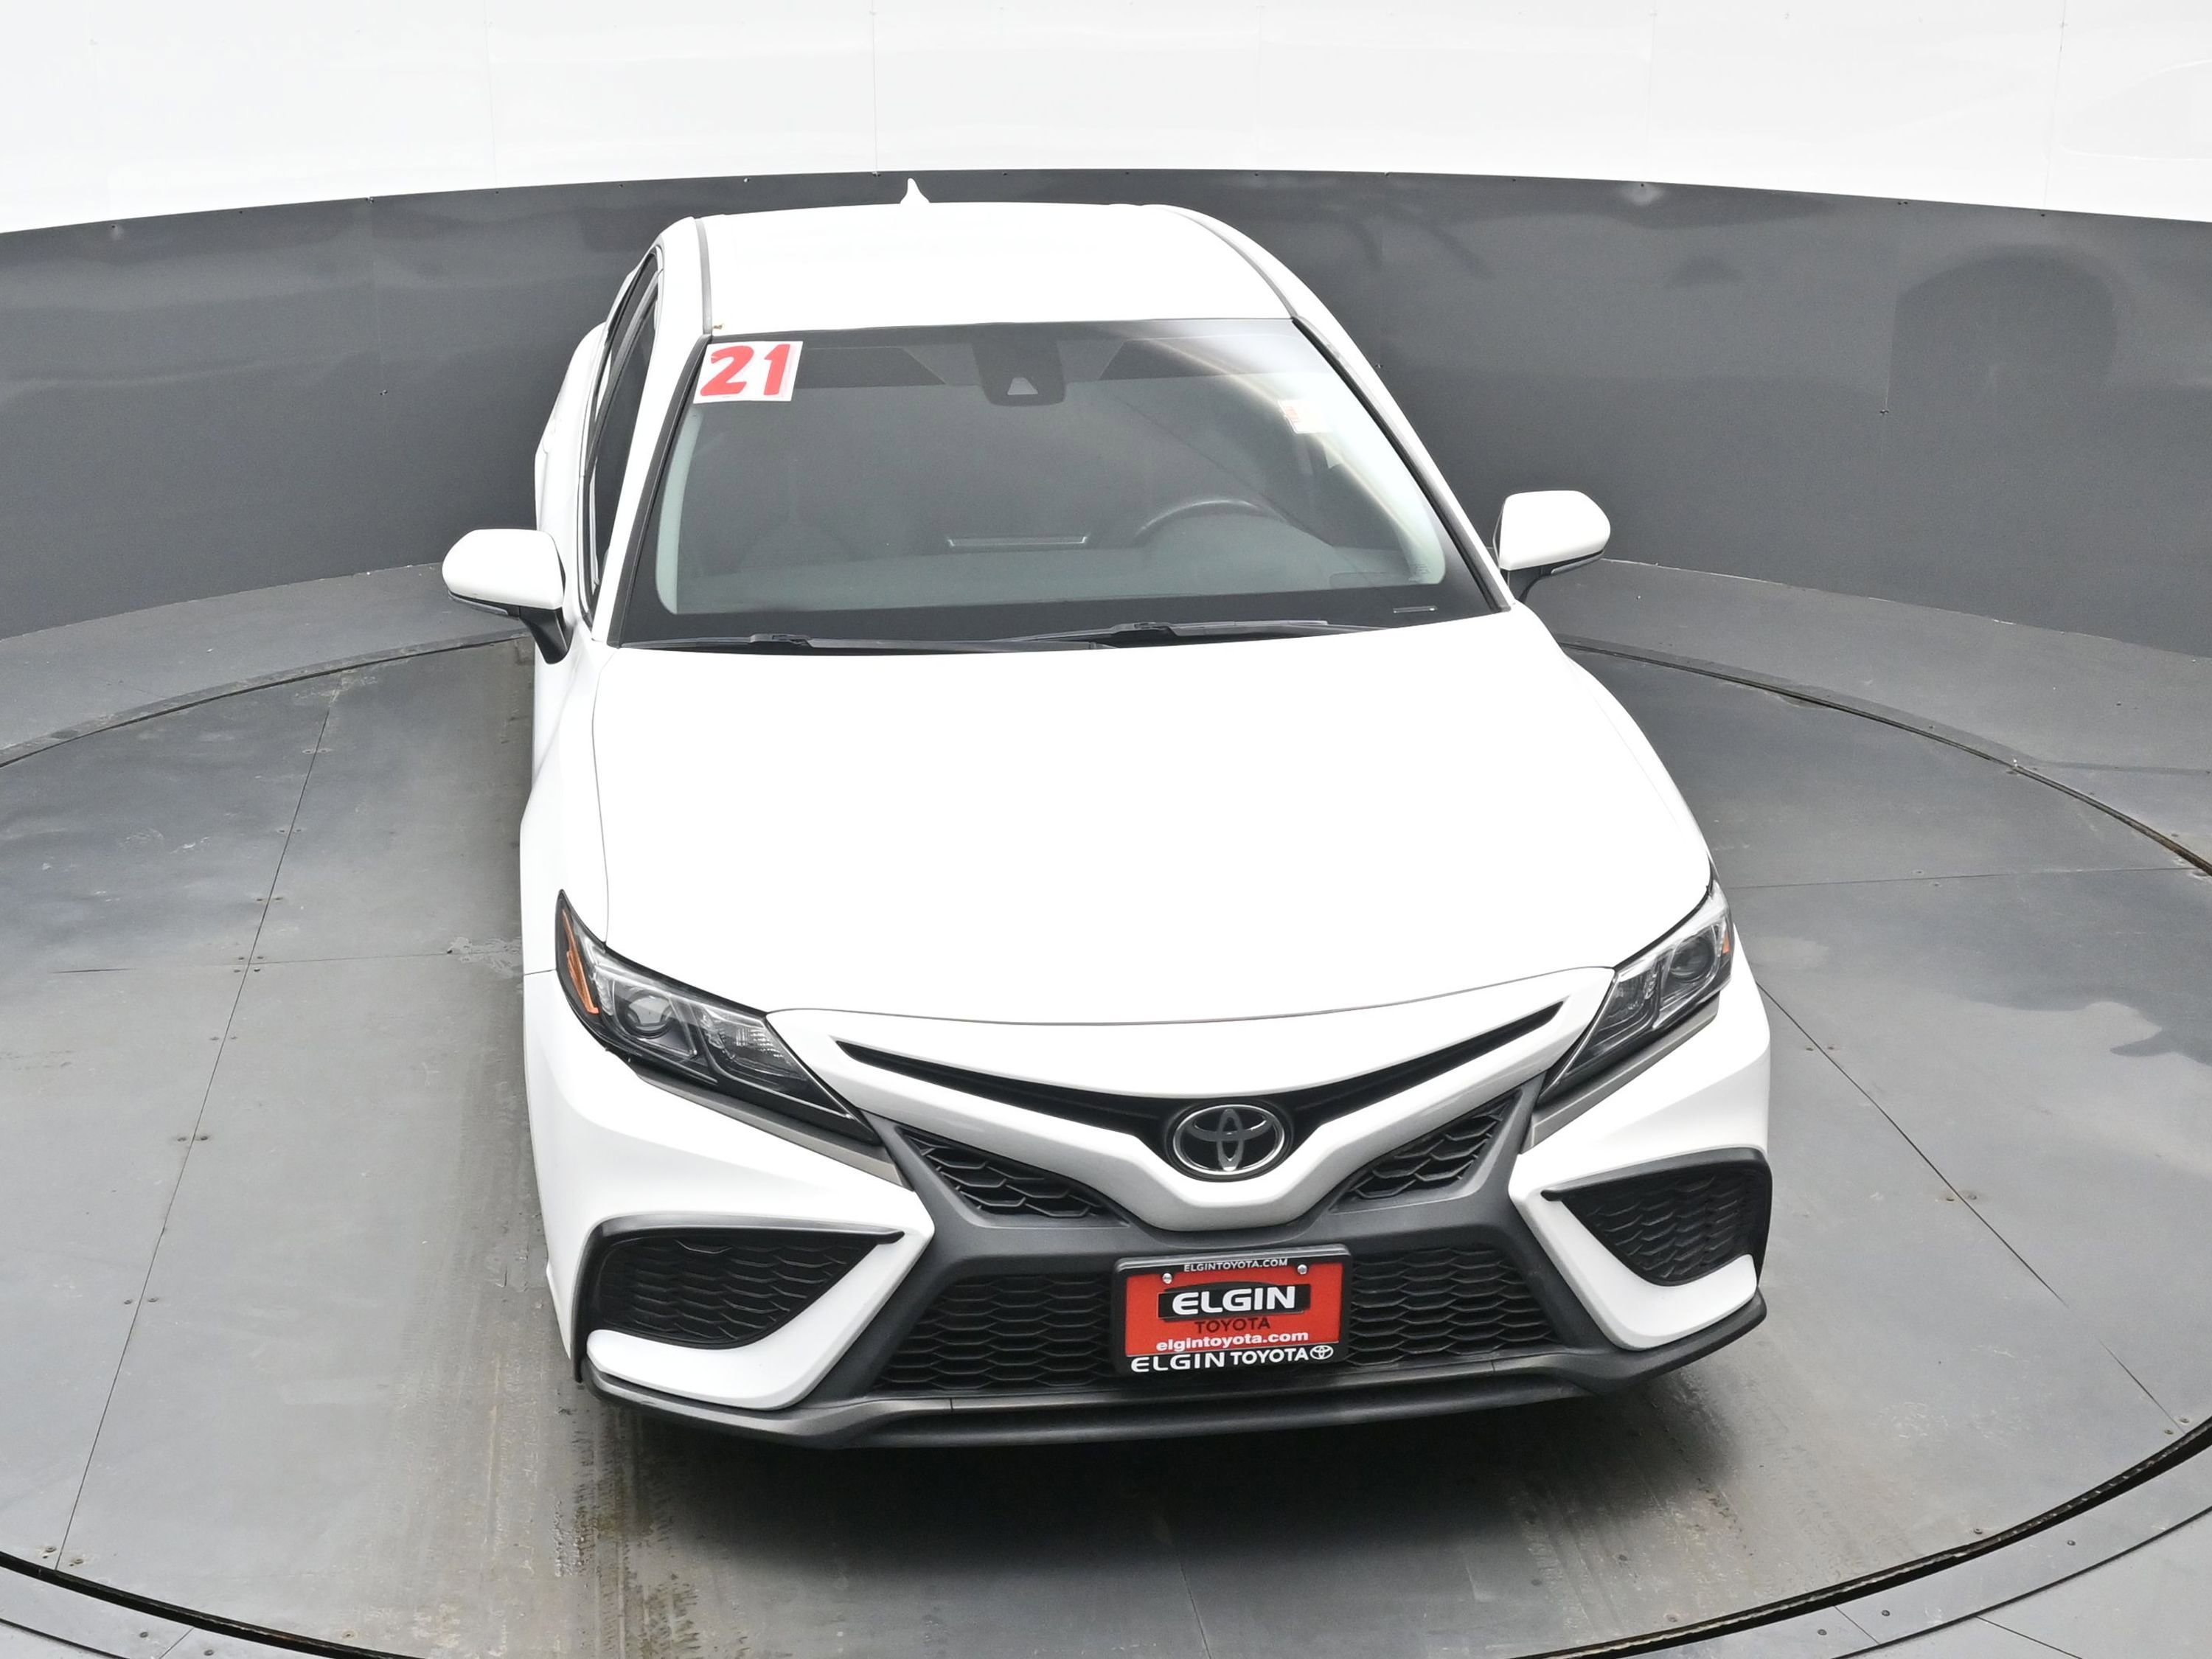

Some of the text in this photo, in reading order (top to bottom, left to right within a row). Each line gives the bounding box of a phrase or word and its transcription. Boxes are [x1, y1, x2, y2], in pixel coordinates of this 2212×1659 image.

[700, 344, 790, 396] 21
[1183, 1259, 1288, 1273] ELGINTOYOTA.COM
[1172, 1286, 1295, 1315] ELGIN
[1194, 1317, 1271, 1334] TOYOTA
[1156, 1331, 1309, 1352] elgintoyota.com
[1130, 1347, 1310, 1373] ELGIN TOYOTA
